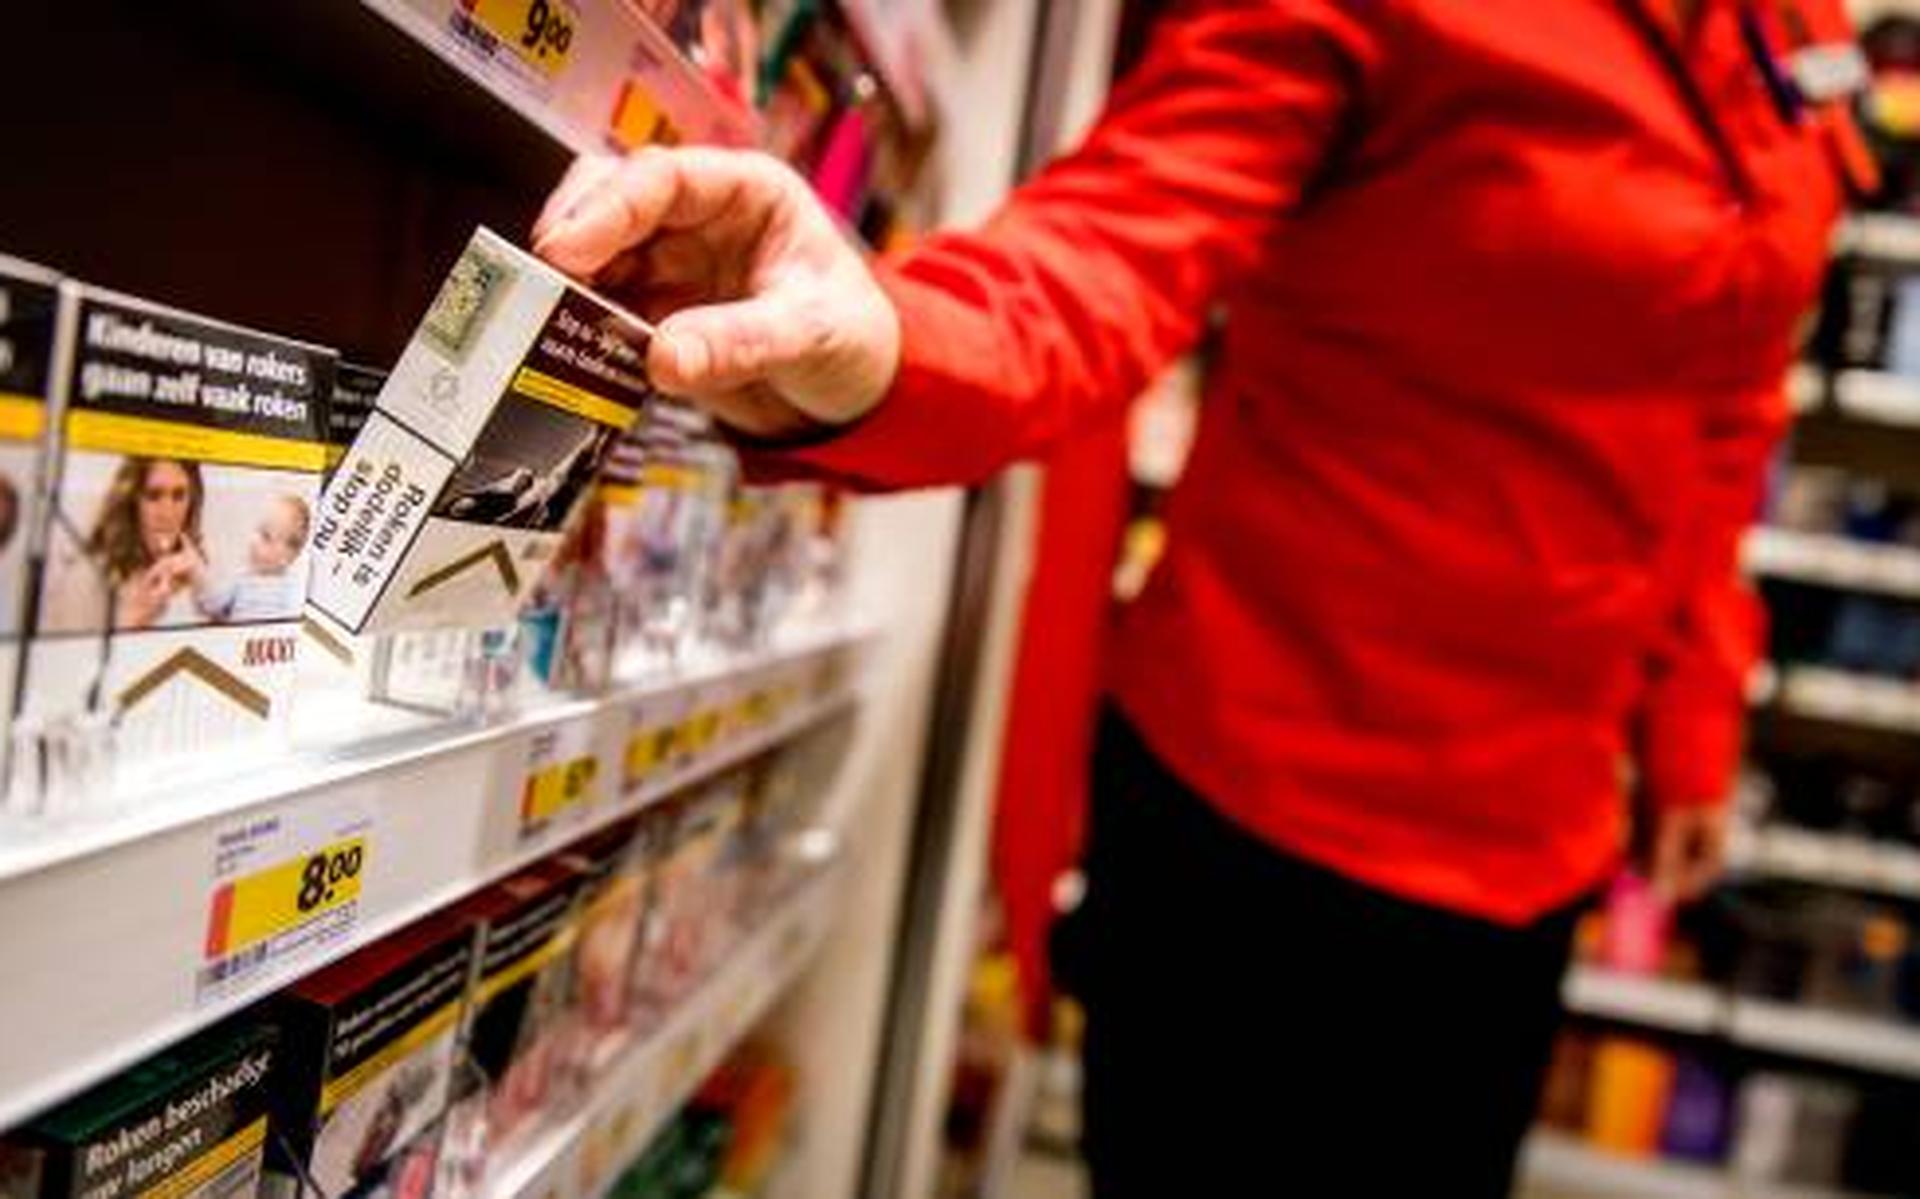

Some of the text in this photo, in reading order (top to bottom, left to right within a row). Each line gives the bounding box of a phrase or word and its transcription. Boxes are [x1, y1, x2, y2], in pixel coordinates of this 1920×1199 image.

[521, 0, 572, 58] 9.00
[87, 312, 306, 385] Kinderen van rokers
[82, 362, 150, 399] gaan
[152, 372, 200, 403] zelf
[202, 384, 250, 413] vaak
[253, 391, 307, 421] roken
[333, 459, 373, 514] stop
[338, 463, 402, 558] dodelijk
[313, 517, 338, 550] nu
[352, 483, 425, 586] Roken is
[297, 846, 361, 912] 8.00
[86, 1117, 162, 1177] Roken
